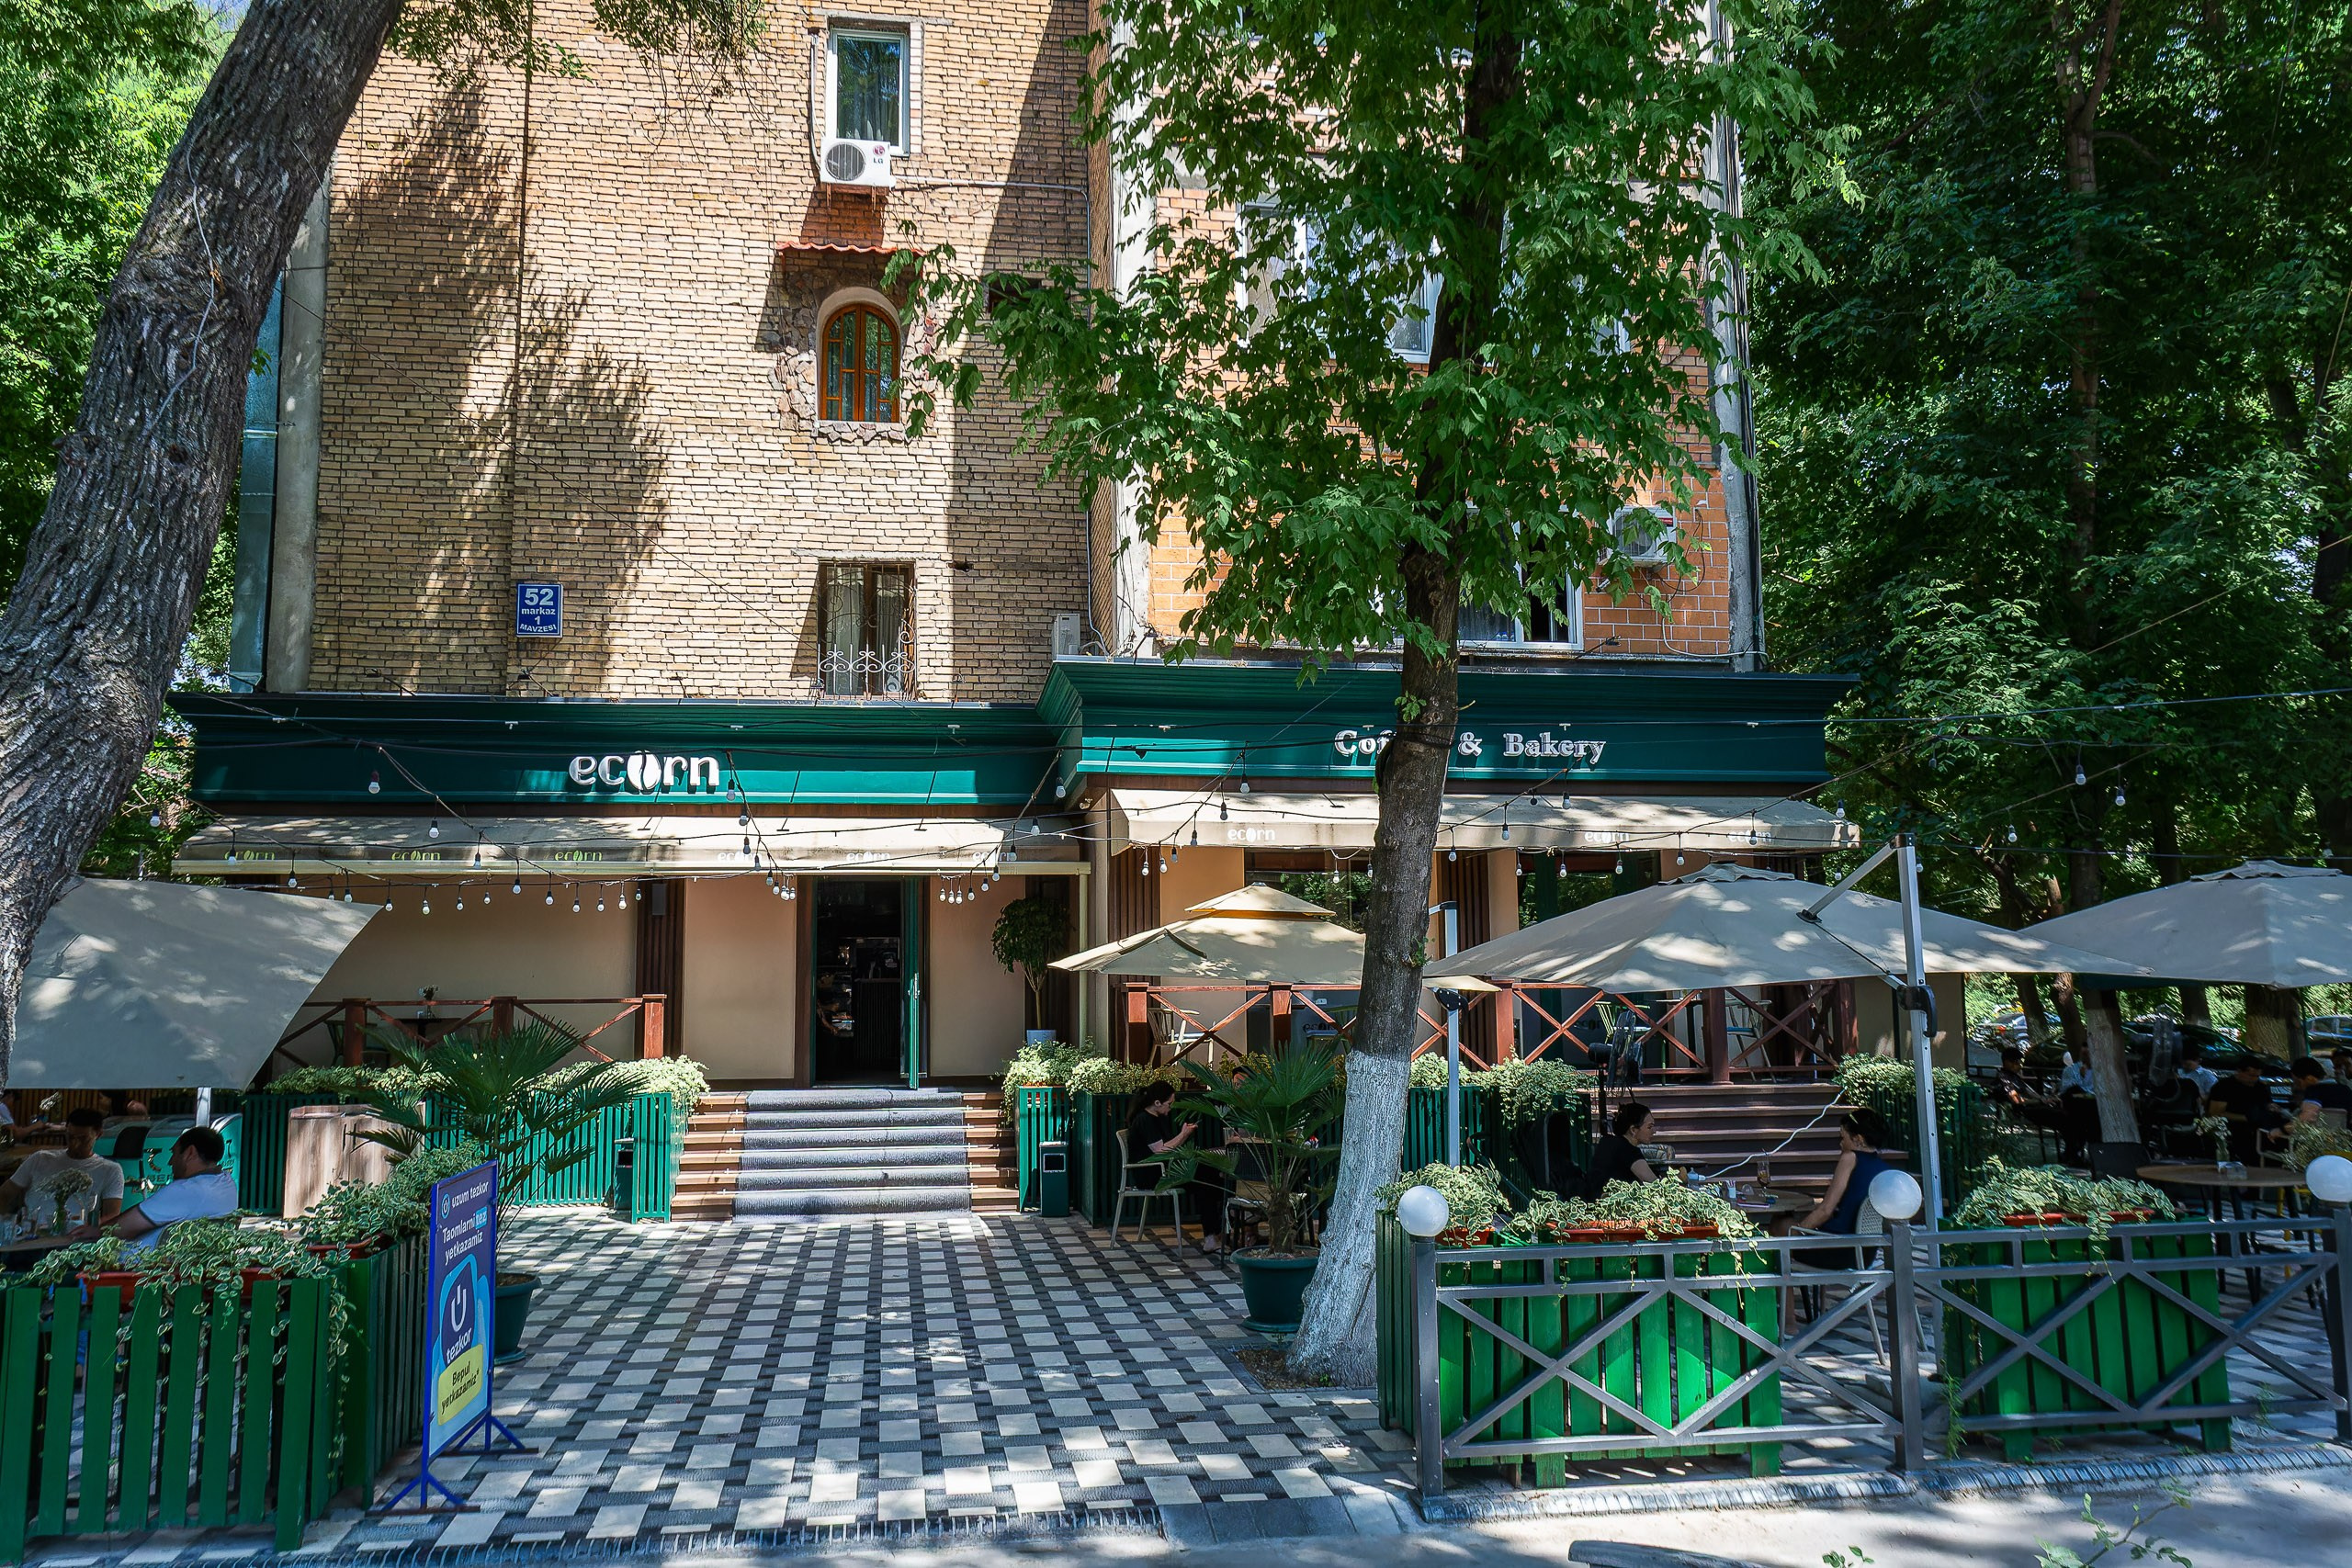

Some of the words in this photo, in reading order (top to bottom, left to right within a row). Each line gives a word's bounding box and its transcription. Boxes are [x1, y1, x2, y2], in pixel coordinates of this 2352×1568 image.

[525, 588, 554, 606] 52
[521, 607, 556, 615] markaz
[534, 615, 541, 625] 1
[519, 623, 557, 632] MAVZESI
[1335, 730, 1396, 755] Cof
[1458, 732, 1483, 757] &
[1503, 732, 1607, 764] Bakery
[569, 750, 720, 791] ecorn
[1227, 828, 1275, 842] ecorn
[1584, 831, 1629, 843] ecorn
[451, 1190, 469, 1208] uzum
[469, 1180, 489, 1199] tezkor
[442, 1213, 476, 1244] Taomlarni
[475, 1210, 487, 1226] tez
[445, 1230, 483, 1266] yetkazamiz
[446, 1327, 472, 1364] tezkor
[452, 1360, 470, 1386] Bepul
